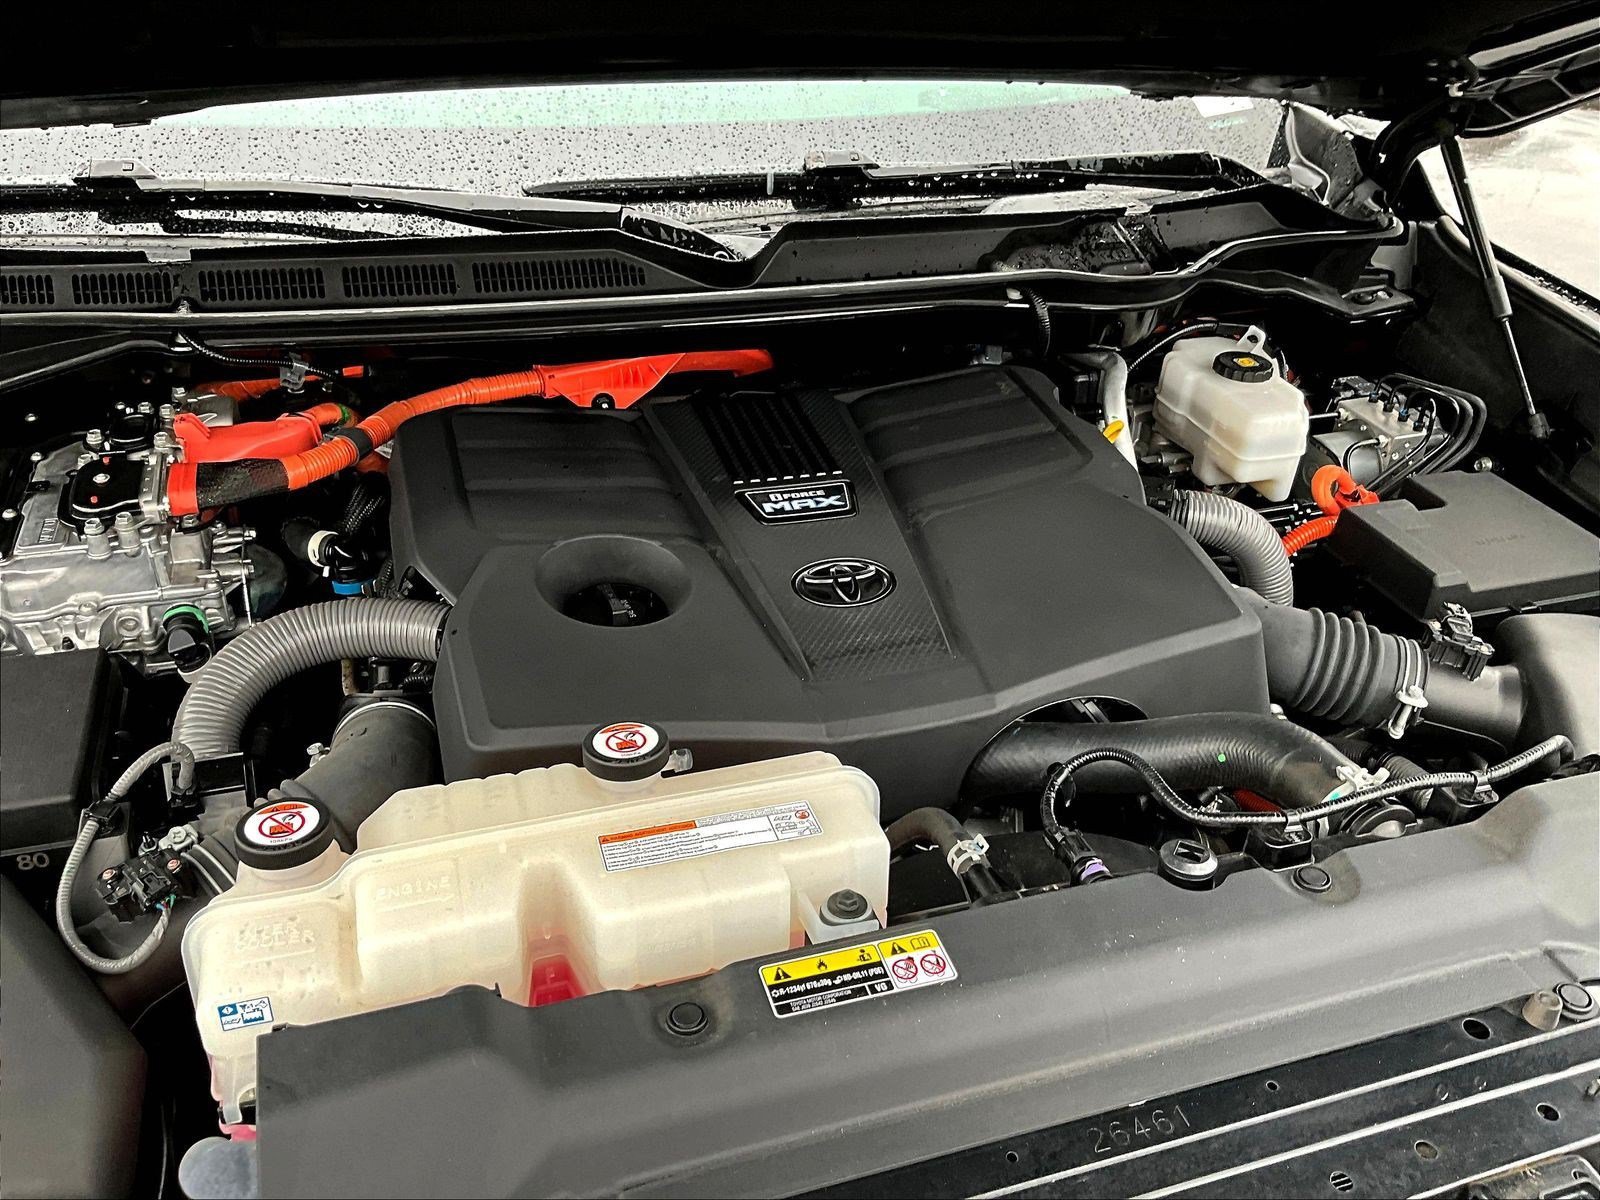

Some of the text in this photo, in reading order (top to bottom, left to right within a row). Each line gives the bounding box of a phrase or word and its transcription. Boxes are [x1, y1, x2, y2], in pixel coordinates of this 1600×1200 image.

[762, 495, 845, 513] MAX
[16, 852, 50, 870] 80
[375, 876, 451, 900] ENGINE
[1086, 1105, 1191, 1153] 26461
